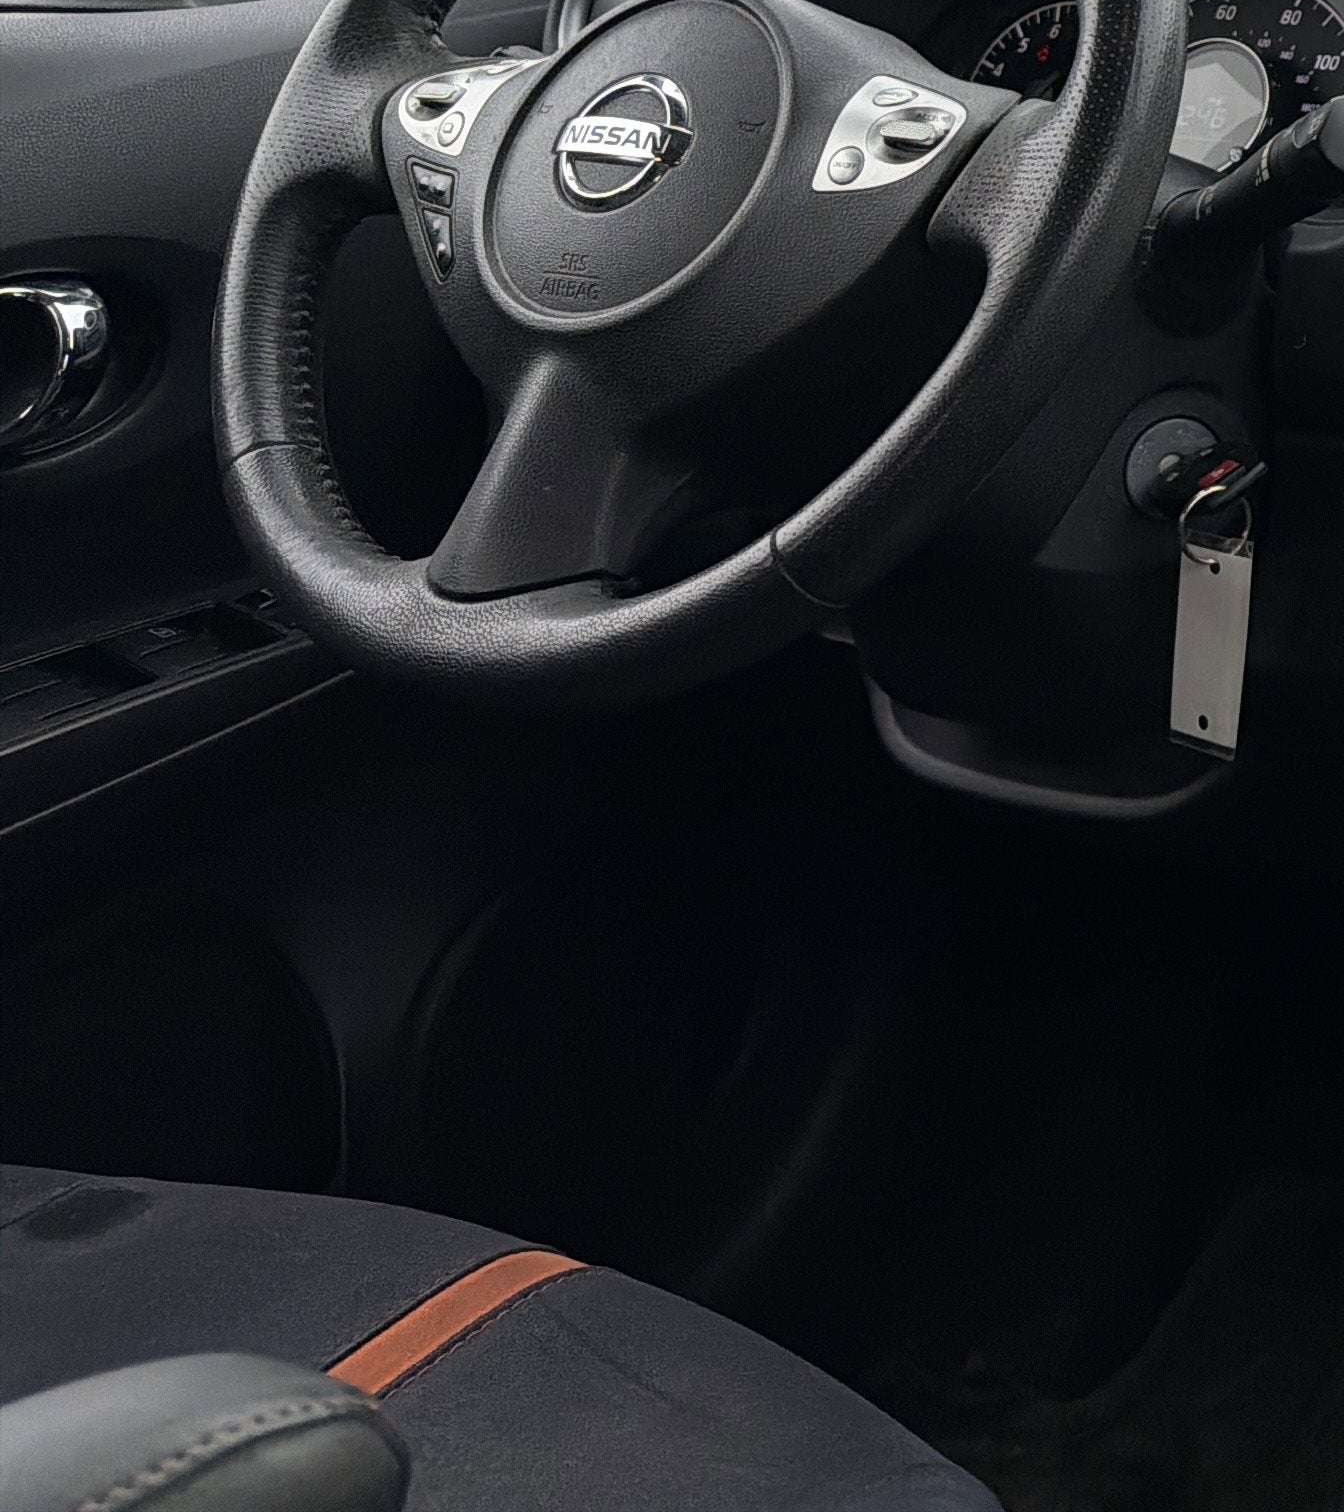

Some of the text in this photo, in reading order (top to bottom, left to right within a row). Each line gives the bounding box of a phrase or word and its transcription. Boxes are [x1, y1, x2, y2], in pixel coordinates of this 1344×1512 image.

[1215, 5, 1237, 21] 60
[1280, 9, 1302, 26] 80
[1050, 24, 1062, 39] 6
[1017, 37, 1030, 54] 5
[993, 62, 1005, 77] 4
[1314, 54, 1341, 71] 100
[564, 125, 672, 154] NISSAN
[559, 252, 587, 272] SRS
[539, 277, 600, 300] AIRBAG
